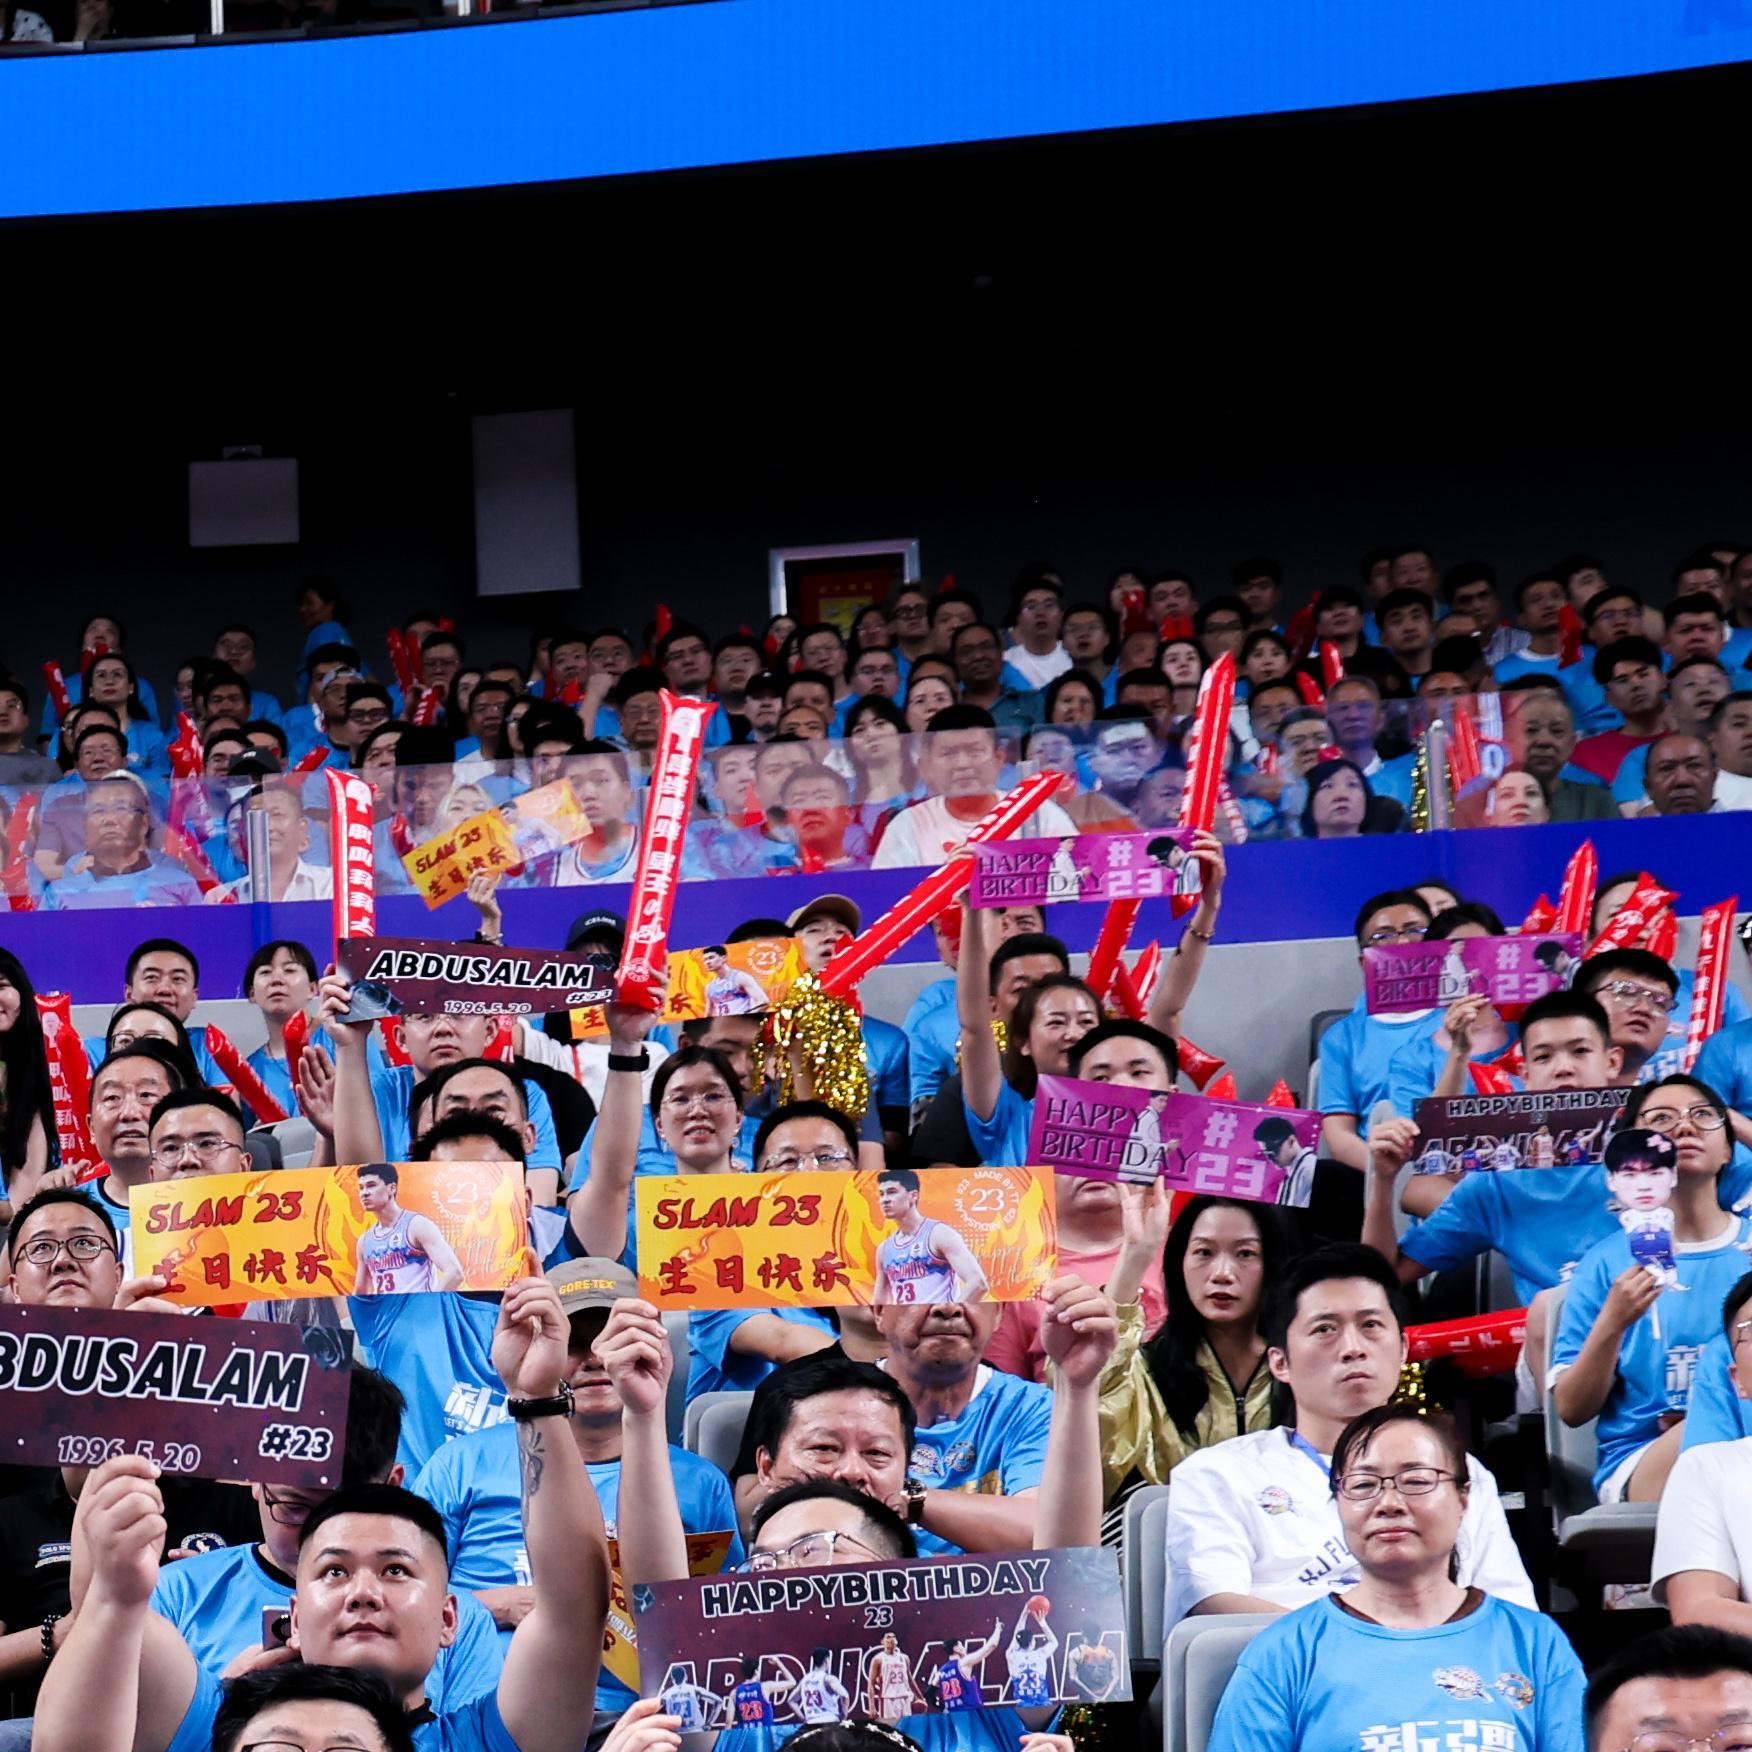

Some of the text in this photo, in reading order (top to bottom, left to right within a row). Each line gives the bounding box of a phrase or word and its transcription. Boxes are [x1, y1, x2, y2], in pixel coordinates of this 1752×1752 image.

[1108, 868, 1164, 897] 23
[365, 949, 595, 990] ABDUSALAM
[444, 1000, 532, 1015] 1996.5.20
[1046, 1097, 1151, 1134] HAPPY
[1448, 1089, 1632, 1118] HAPPYBIRTHDAY
[1041, 1130, 1199, 1174] BIRTHDAY
[1195, 1151, 1267, 1198] 23
[145, 1190, 304, 1234] SLAM 23
[653, 1194, 822, 1229] SLAM 23
[970, 1188, 1005, 1212] 23
[152, 1243, 334, 1293] 生日快乐
[659, 1251, 850, 1295] 生日快乐
[558, 1279, 616, 1298] GORE-TEX
[58, 1434, 202, 1473] 19965.20
[258, 1422, 334, 1462] #23
[700, 1557, 1051, 1618] HAPPYBIRTHDAY
[863, 1606, 895, 1629] 23
